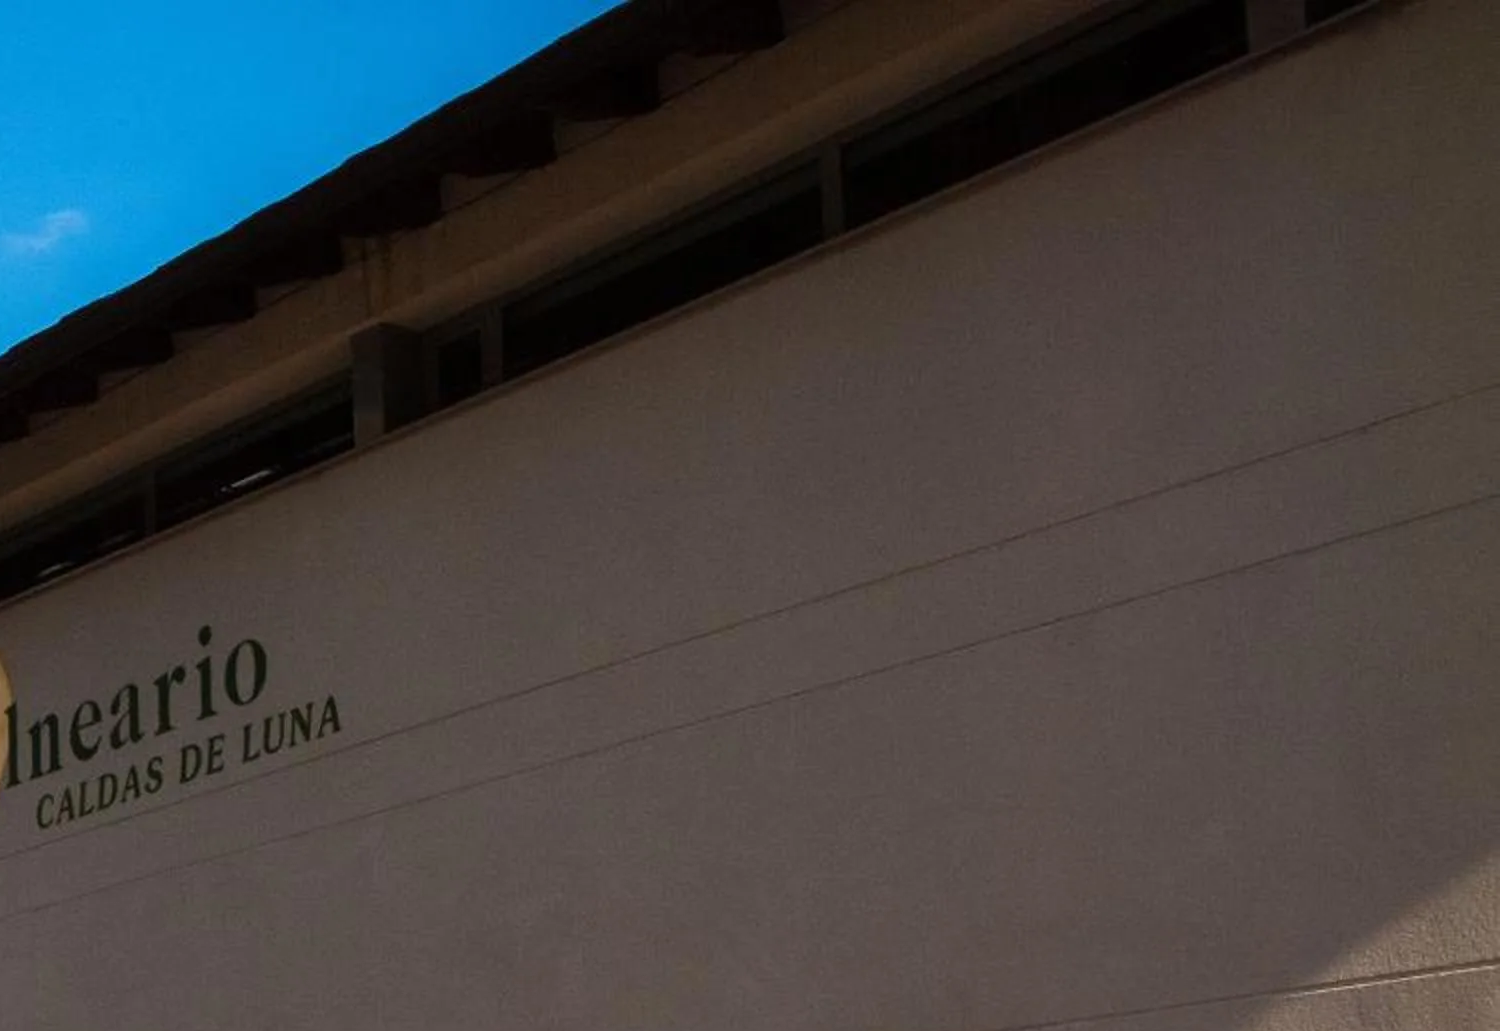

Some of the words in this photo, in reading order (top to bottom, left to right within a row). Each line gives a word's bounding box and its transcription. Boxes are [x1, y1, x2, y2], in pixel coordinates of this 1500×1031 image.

[36, 755, 163, 830] CALDAS
[179, 733, 226, 784] DE
[241, 694, 342, 763] LUNA
